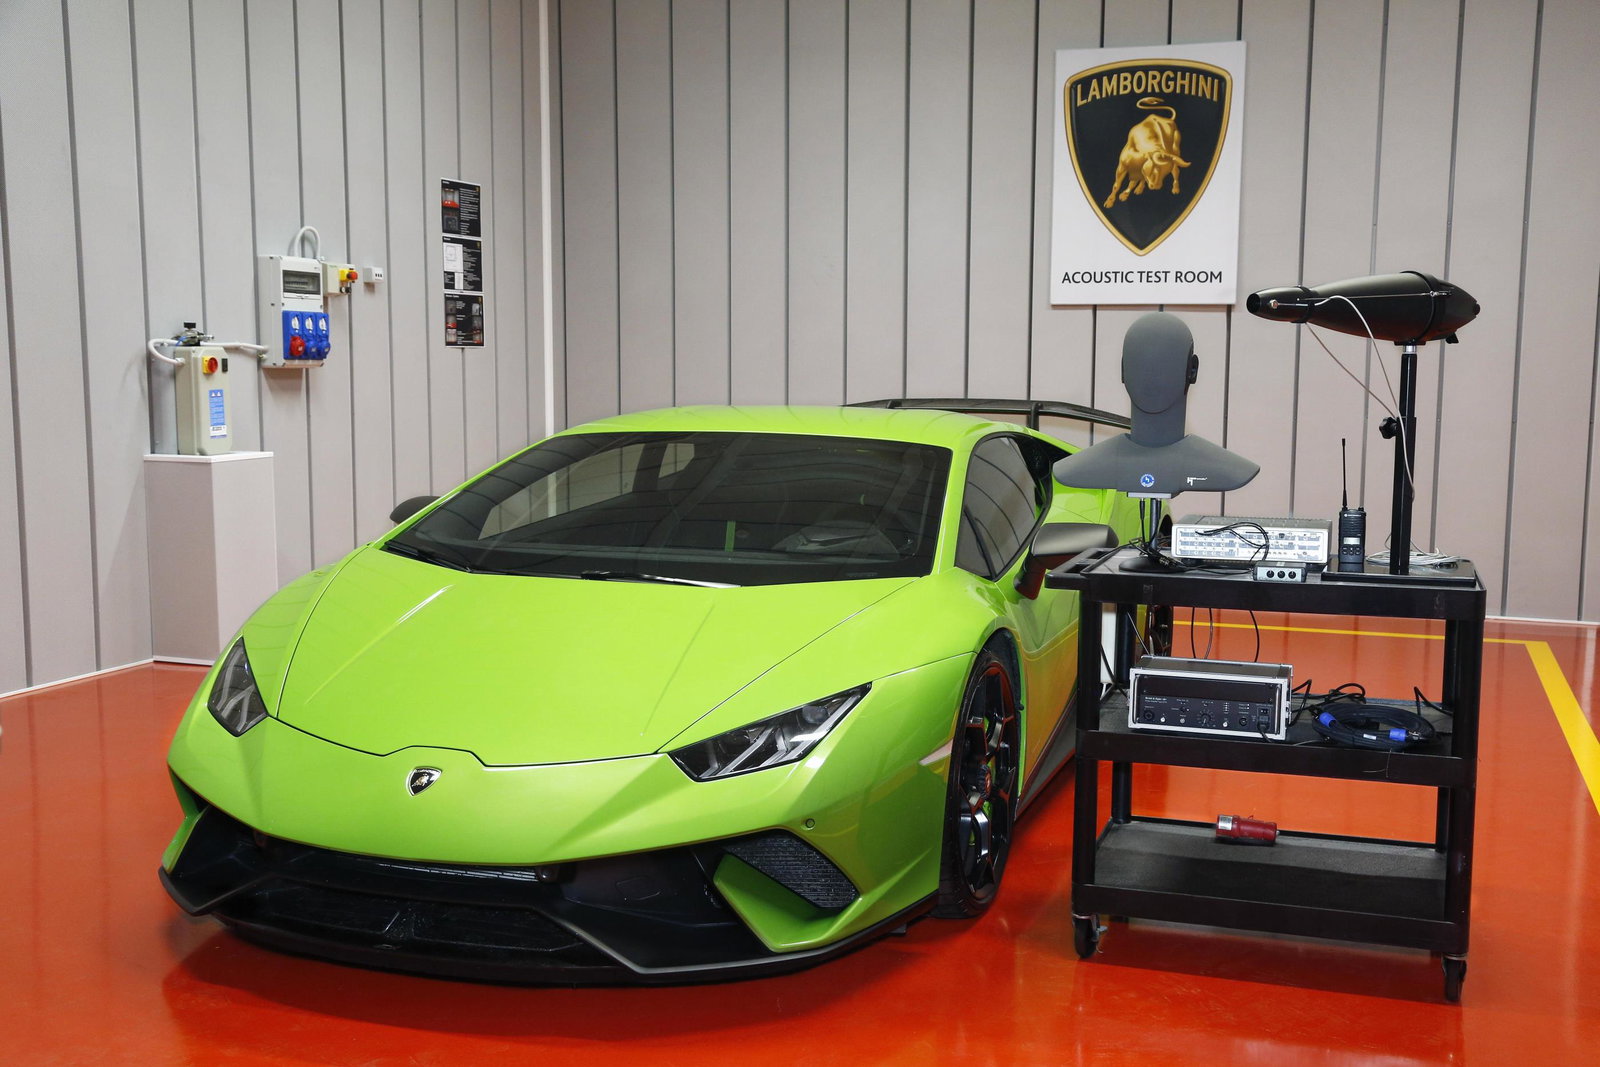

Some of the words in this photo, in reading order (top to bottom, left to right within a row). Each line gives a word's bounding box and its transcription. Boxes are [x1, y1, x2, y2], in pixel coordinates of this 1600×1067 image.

[1077, 70, 1219, 107] LAMBORGHINI
[1062, 271, 1134, 284] ACOUSTIC
[1137, 271, 1170, 283] TEST
[1175, 271, 1222, 283] ROOM
